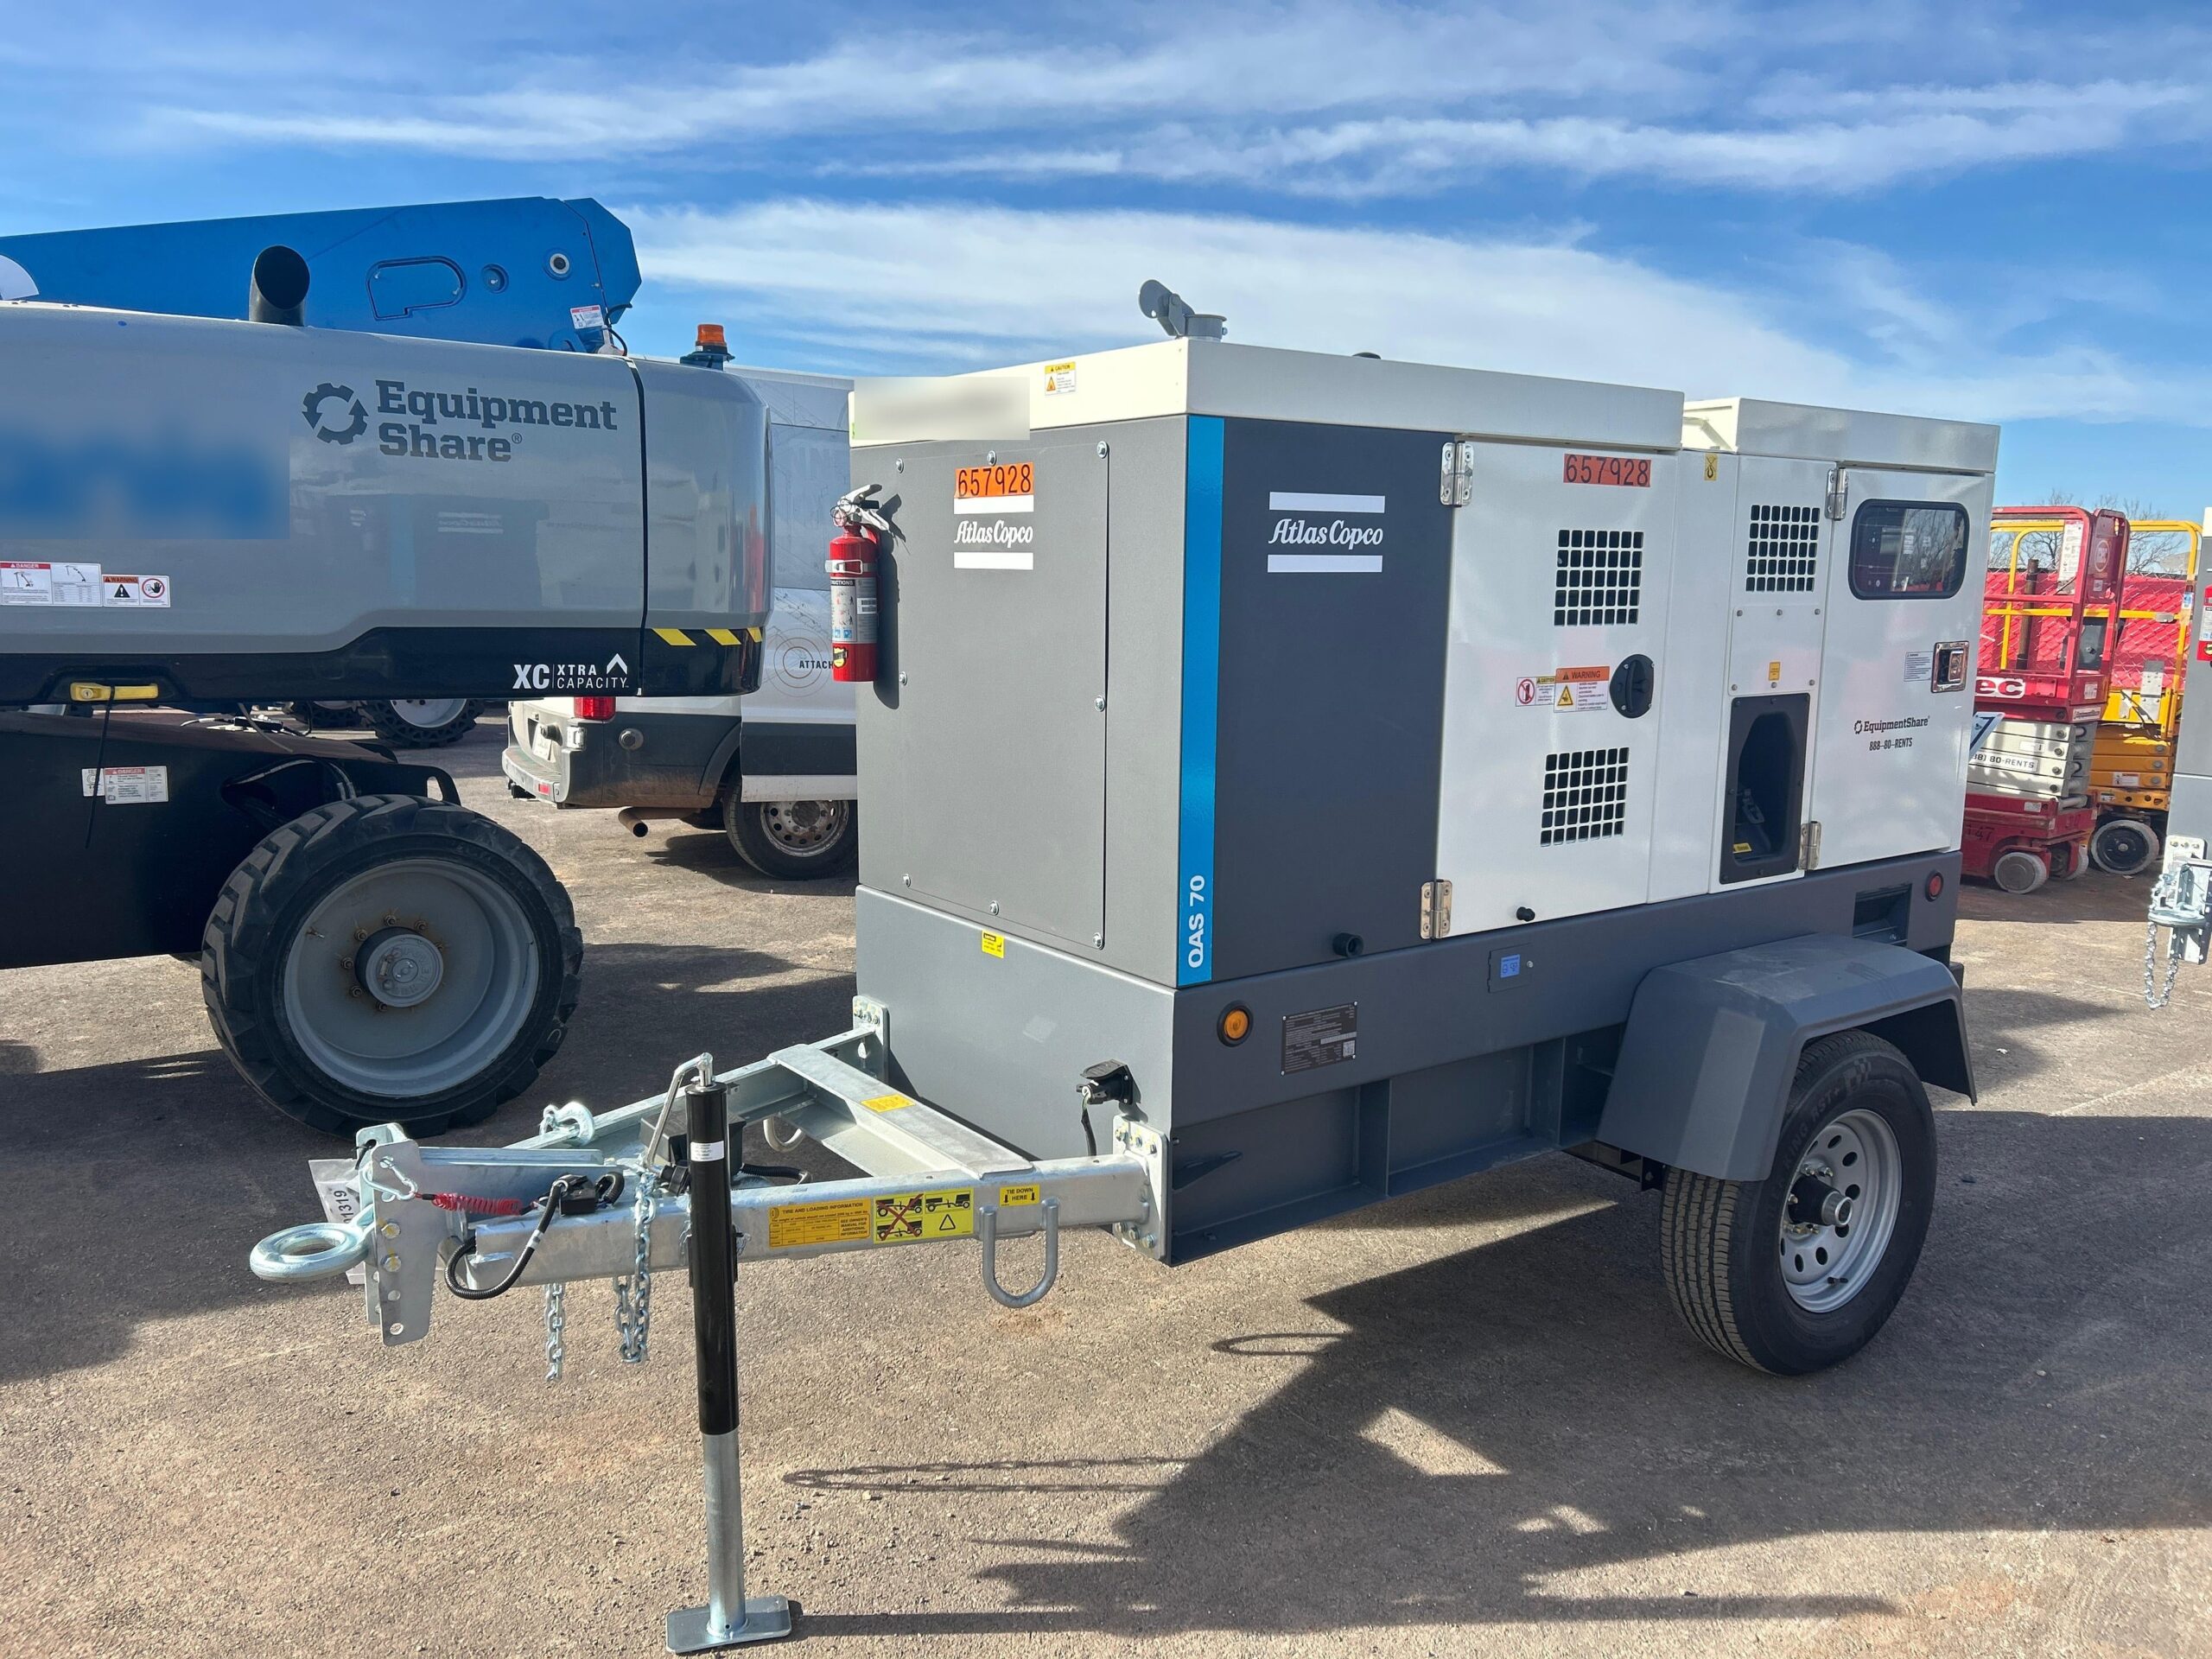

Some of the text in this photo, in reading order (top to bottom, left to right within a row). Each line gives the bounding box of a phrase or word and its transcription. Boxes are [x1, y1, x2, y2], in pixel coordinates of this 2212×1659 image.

[375, 379, 618, 430] Equipment
[957, 464, 1032, 498] 657928
[1566, 454, 1649, 487] 657928
[953, 519, 1033, 549] Atlas Copco
[1268, 518, 1383, 550] Atlas Copco
[512, 664, 550, 690] XC
[556, 677, 628, 689] CAPACITY
[557, 664, 597, 676] XTRA
[1572, 671, 1601, 679] WARNING
[1869, 737, 1913, 751] 888-80-RENTS
[1990, 756, 2035, 768] 80-RENTS
[1188, 874, 1205, 968] QAS 70
